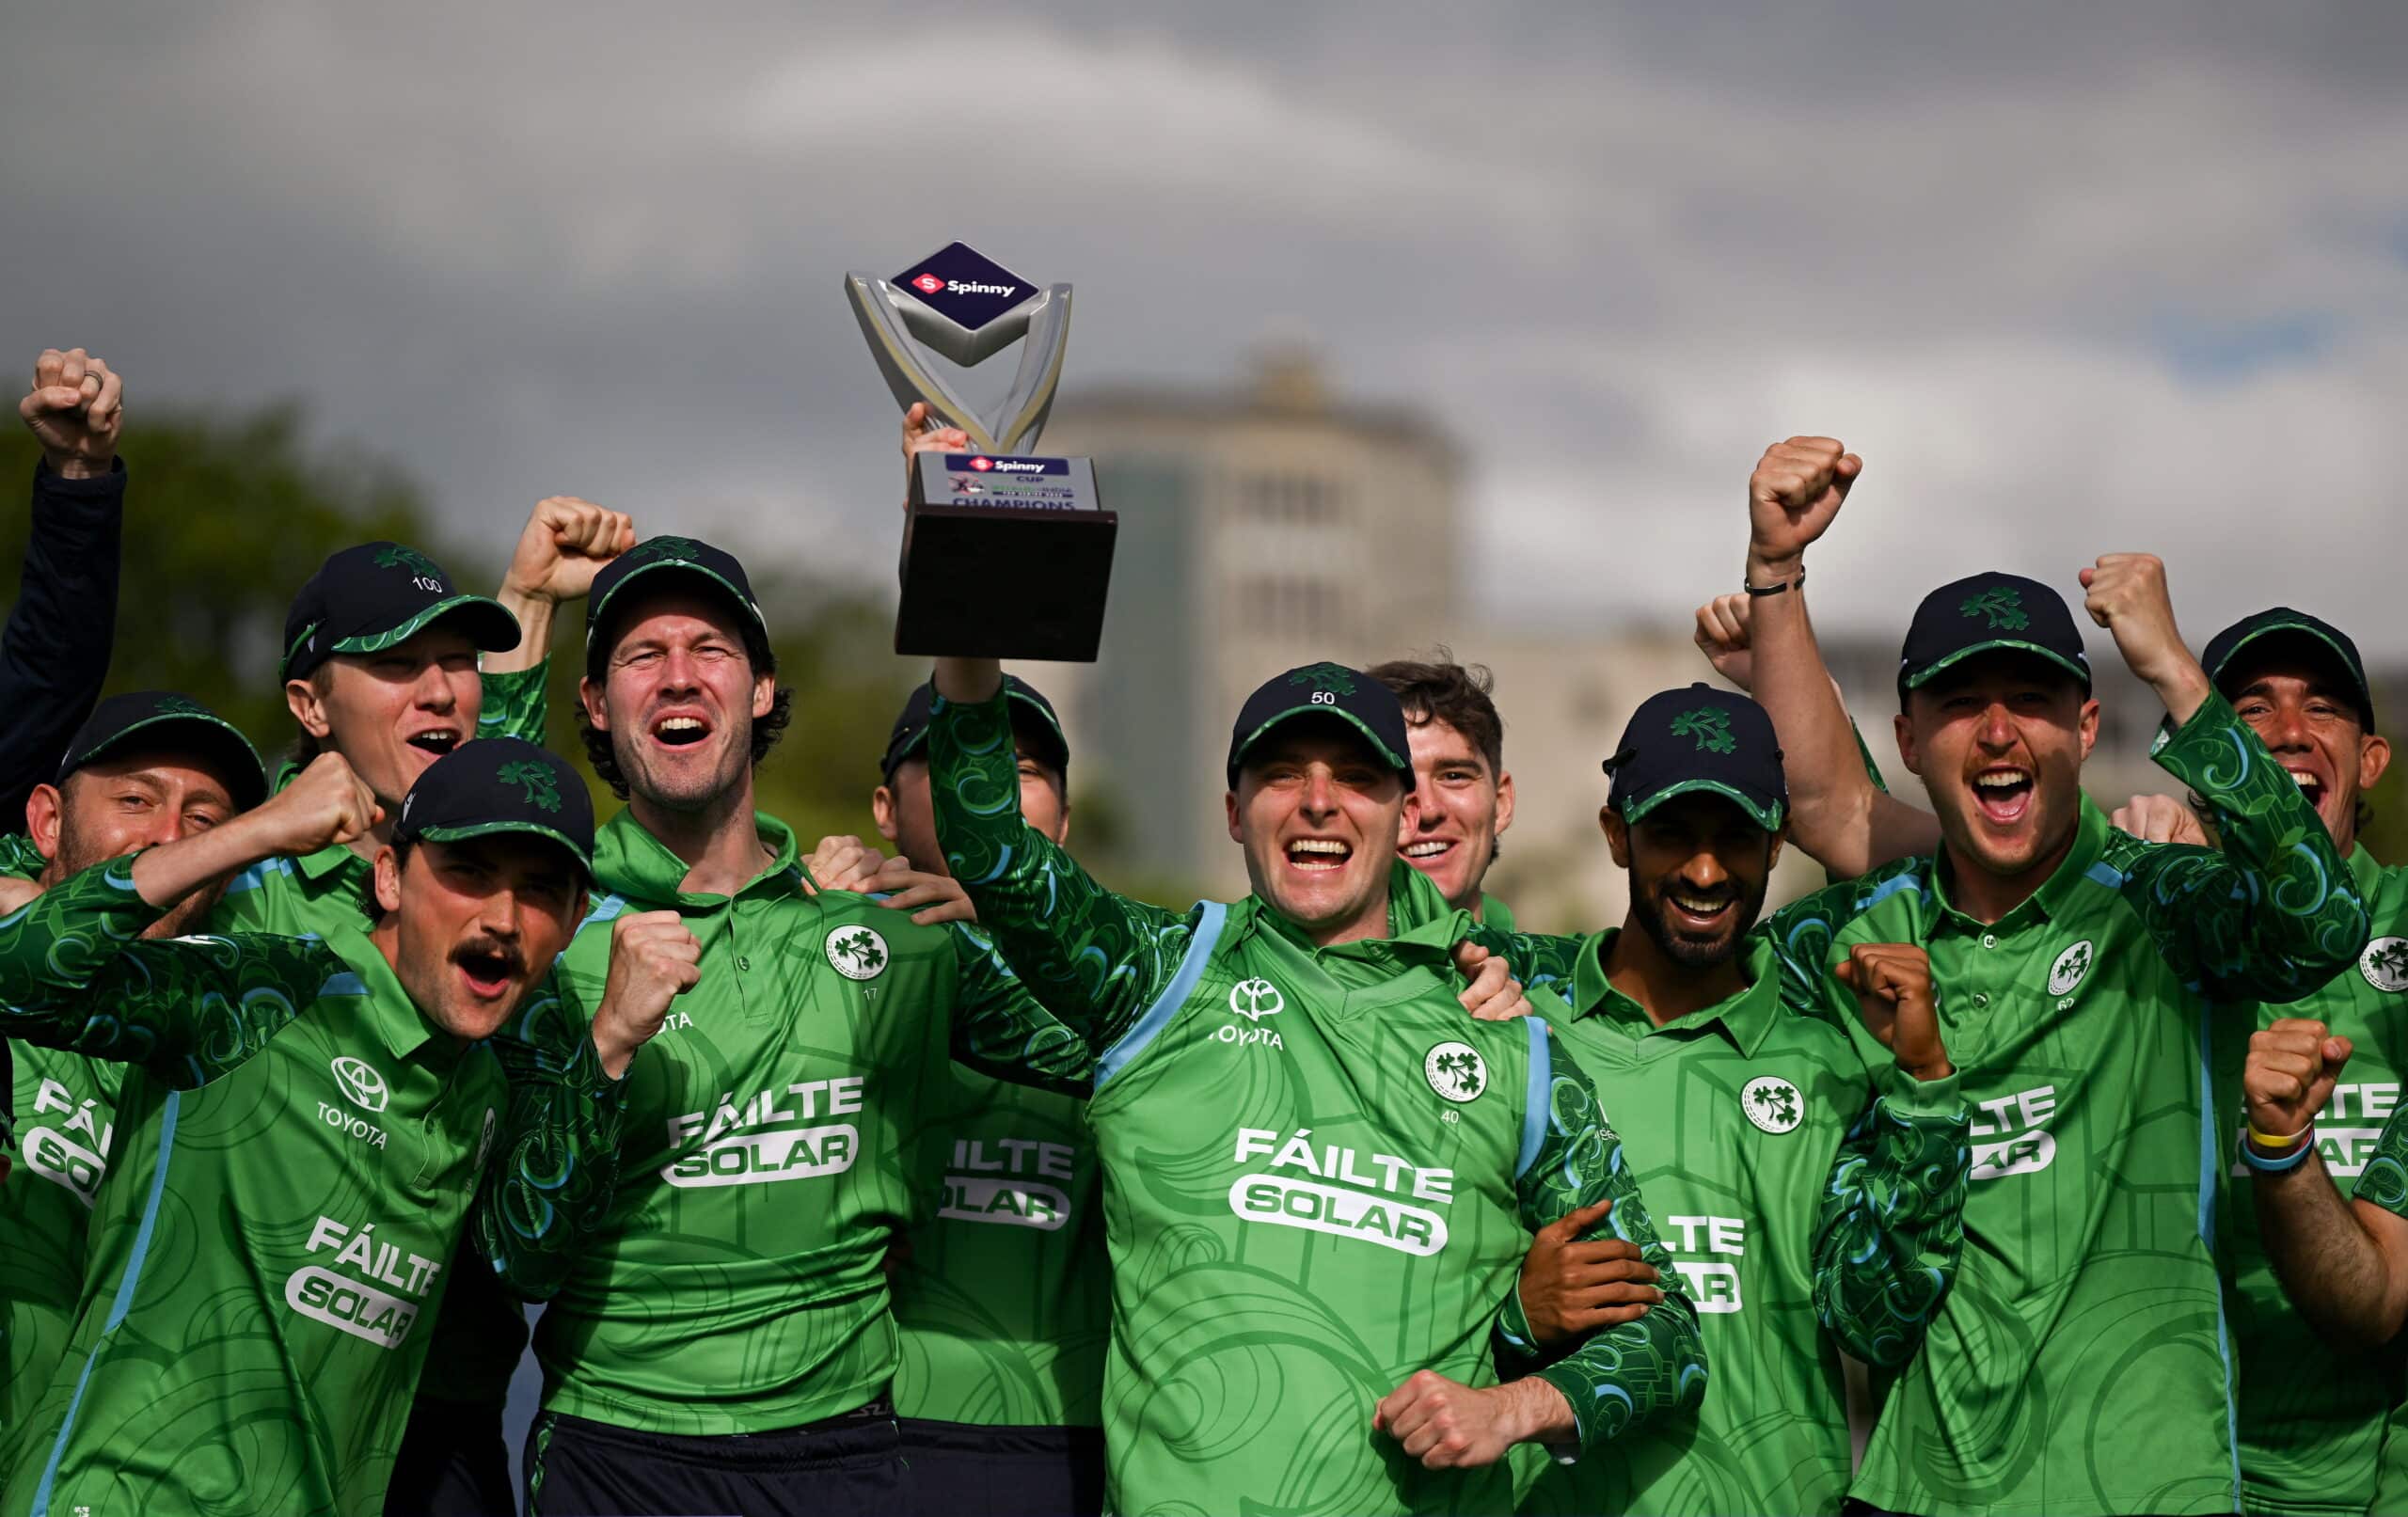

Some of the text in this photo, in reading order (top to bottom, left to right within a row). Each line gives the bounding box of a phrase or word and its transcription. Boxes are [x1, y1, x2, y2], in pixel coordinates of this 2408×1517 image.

[947, 280, 1015, 297] Spinny
[994, 460, 1045, 473] Spinny
[1016, 475, 1044, 483] CUP
[953, 497, 1074, 510] CHAMPIONS
[412, 577, 442, 593] 100
[1311, 691, 1335, 704] 50
[863, 988, 877, 1001] 17
[318, 1101, 388, 1151] TOYOTA
[667, 1077, 863, 1149] FÁILTE
[1440, 1110, 1460, 1124] 40
[673, 1134, 850, 1178] SOLAR
[947, 1138, 1075, 1181] ILTE
[1234, 1128, 1454, 1205] FÁILTE
[1244, 1183, 1434, 1248] SOLAR
[305, 1215, 442, 1298] FÁILTE
[298, 1275, 413, 1341] SOLAR
